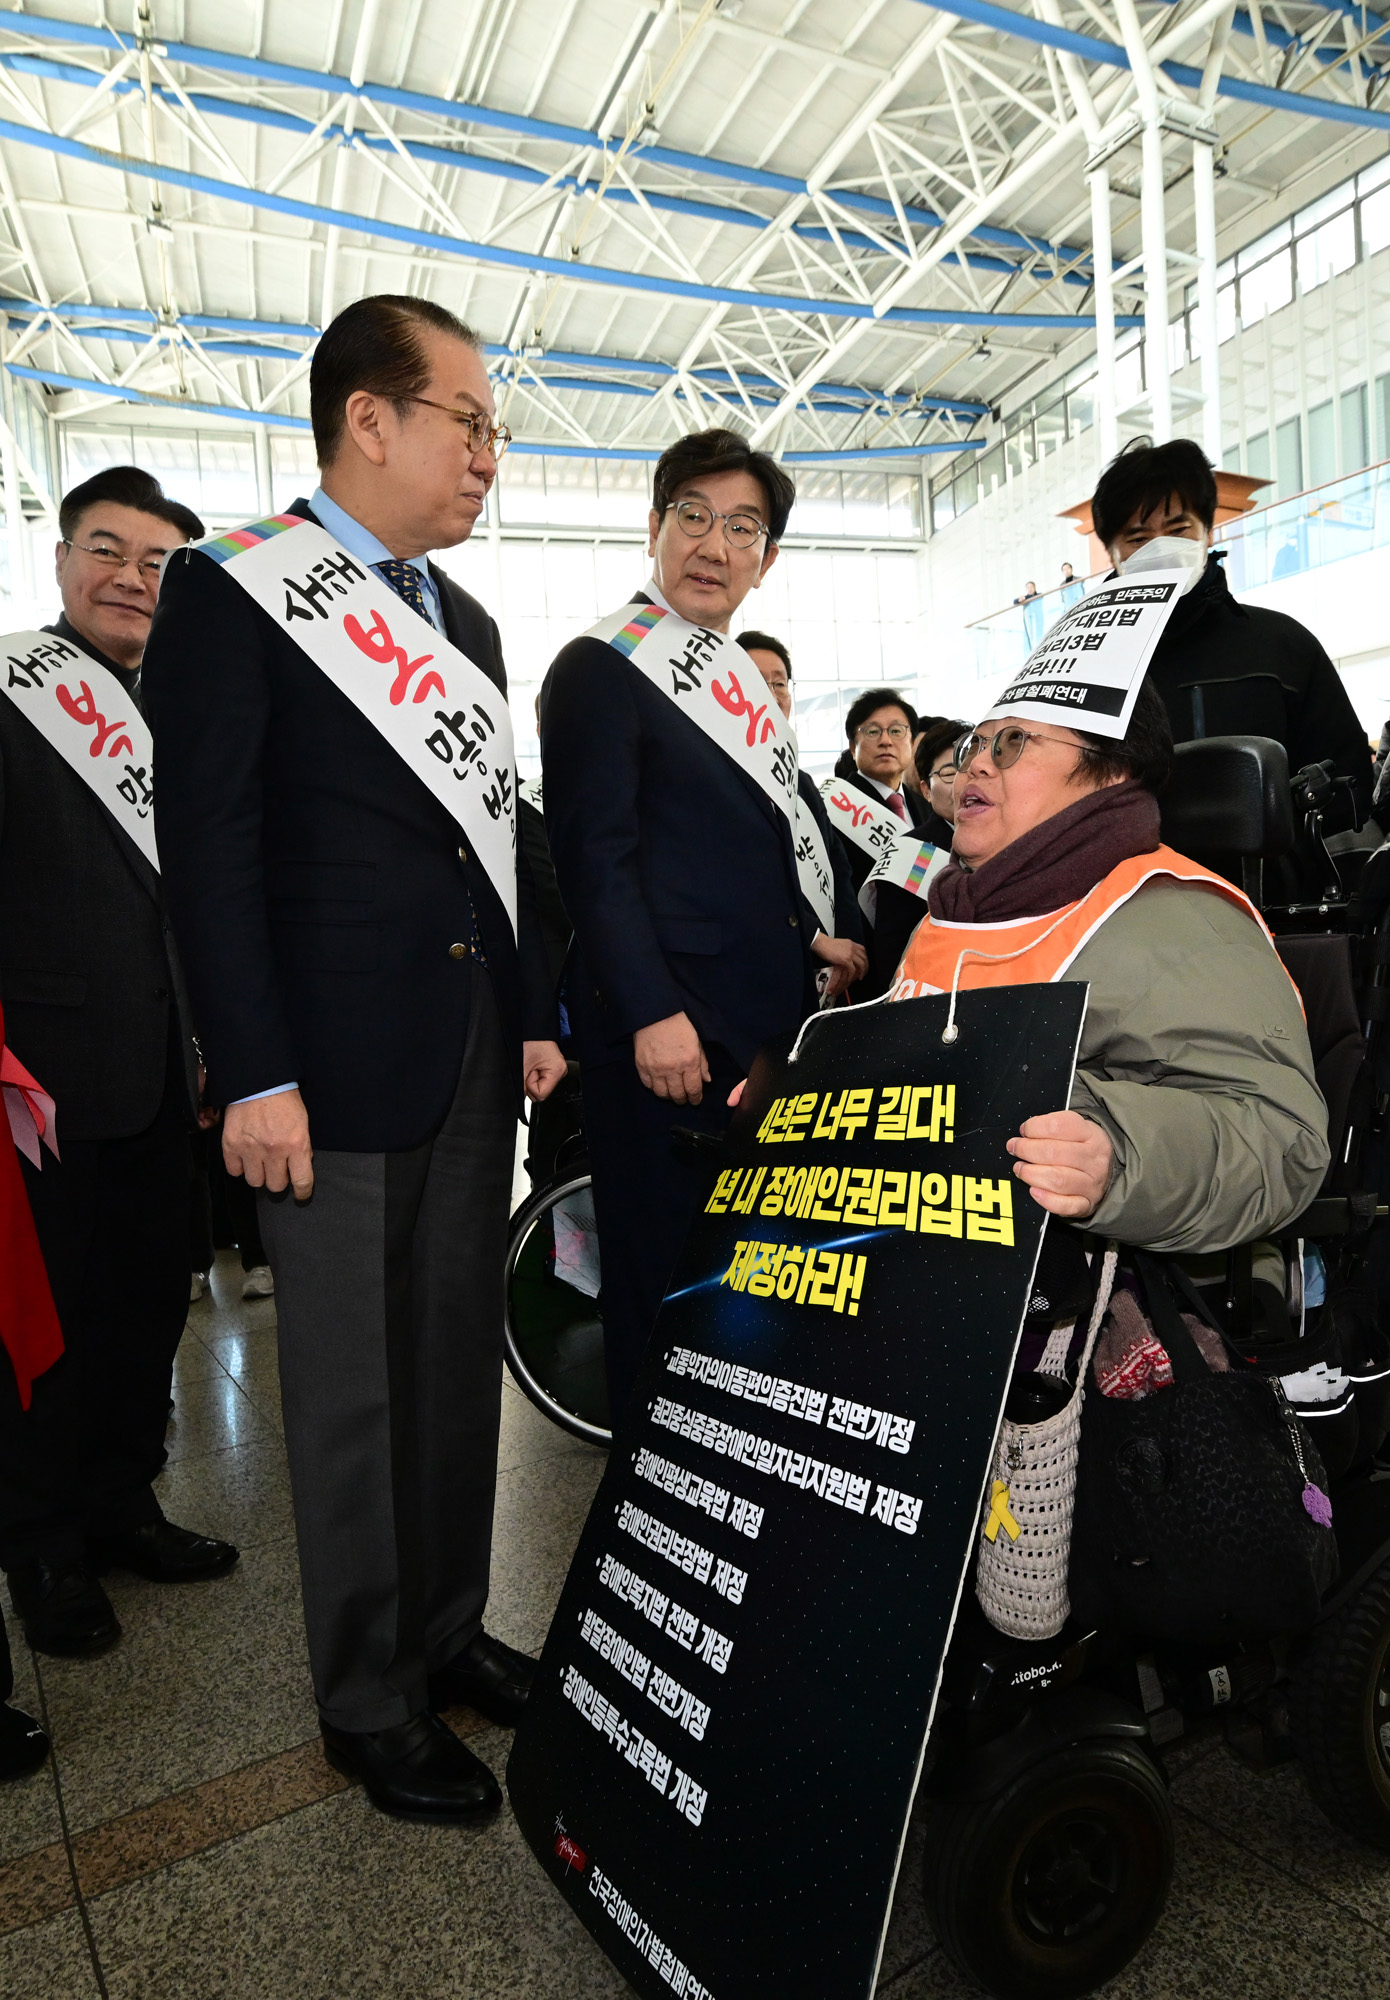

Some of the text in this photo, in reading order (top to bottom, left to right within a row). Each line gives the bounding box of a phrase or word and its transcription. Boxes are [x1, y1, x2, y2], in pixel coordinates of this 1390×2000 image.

[285, 551, 367, 622] 새해
[1047, 607, 1144, 638] 리7대입법
[1115, 586, 1169, 602] 민주주의
[7, 640, 80, 689] 새해
[342, 609, 447, 706] 복
[669, 627, 724, 696] 새해
[997, 684, 1088, 705] 차별철폐연대
[55, 679, 135, 758] 복
[424, 702, 497, 781] 많이
[710, 670, 777, 747] 복
[116, 764, 154, 819] 많
[830, 791, 875, 828] 복
[756, 1084, 956, 1144] 4년은 너무 길다!
[704, 1166, 1015, 1247] 1년 내 장애인권리입법
[720, 1240, 867, 1316] 제정하라!
[666, 1345, 916, 1455] 교통약자의이동편의증진법 전면개정
[634, 1447, 765, 1540] 장애인평생교육법 제정
[650, 1396, 924, 1536] 권리중심중증장애인일자리지원법 제정
[617, 1500, 749, 1606] 장애인권리보장법 제정
[598, 1552, 735, 1675] 장애인복지법 전면 개정
[579, 1607, 712, 1742] 발달장애인법 전면개정
[562, 1664, 708, 1827] 장애인등특수교육법 개정
